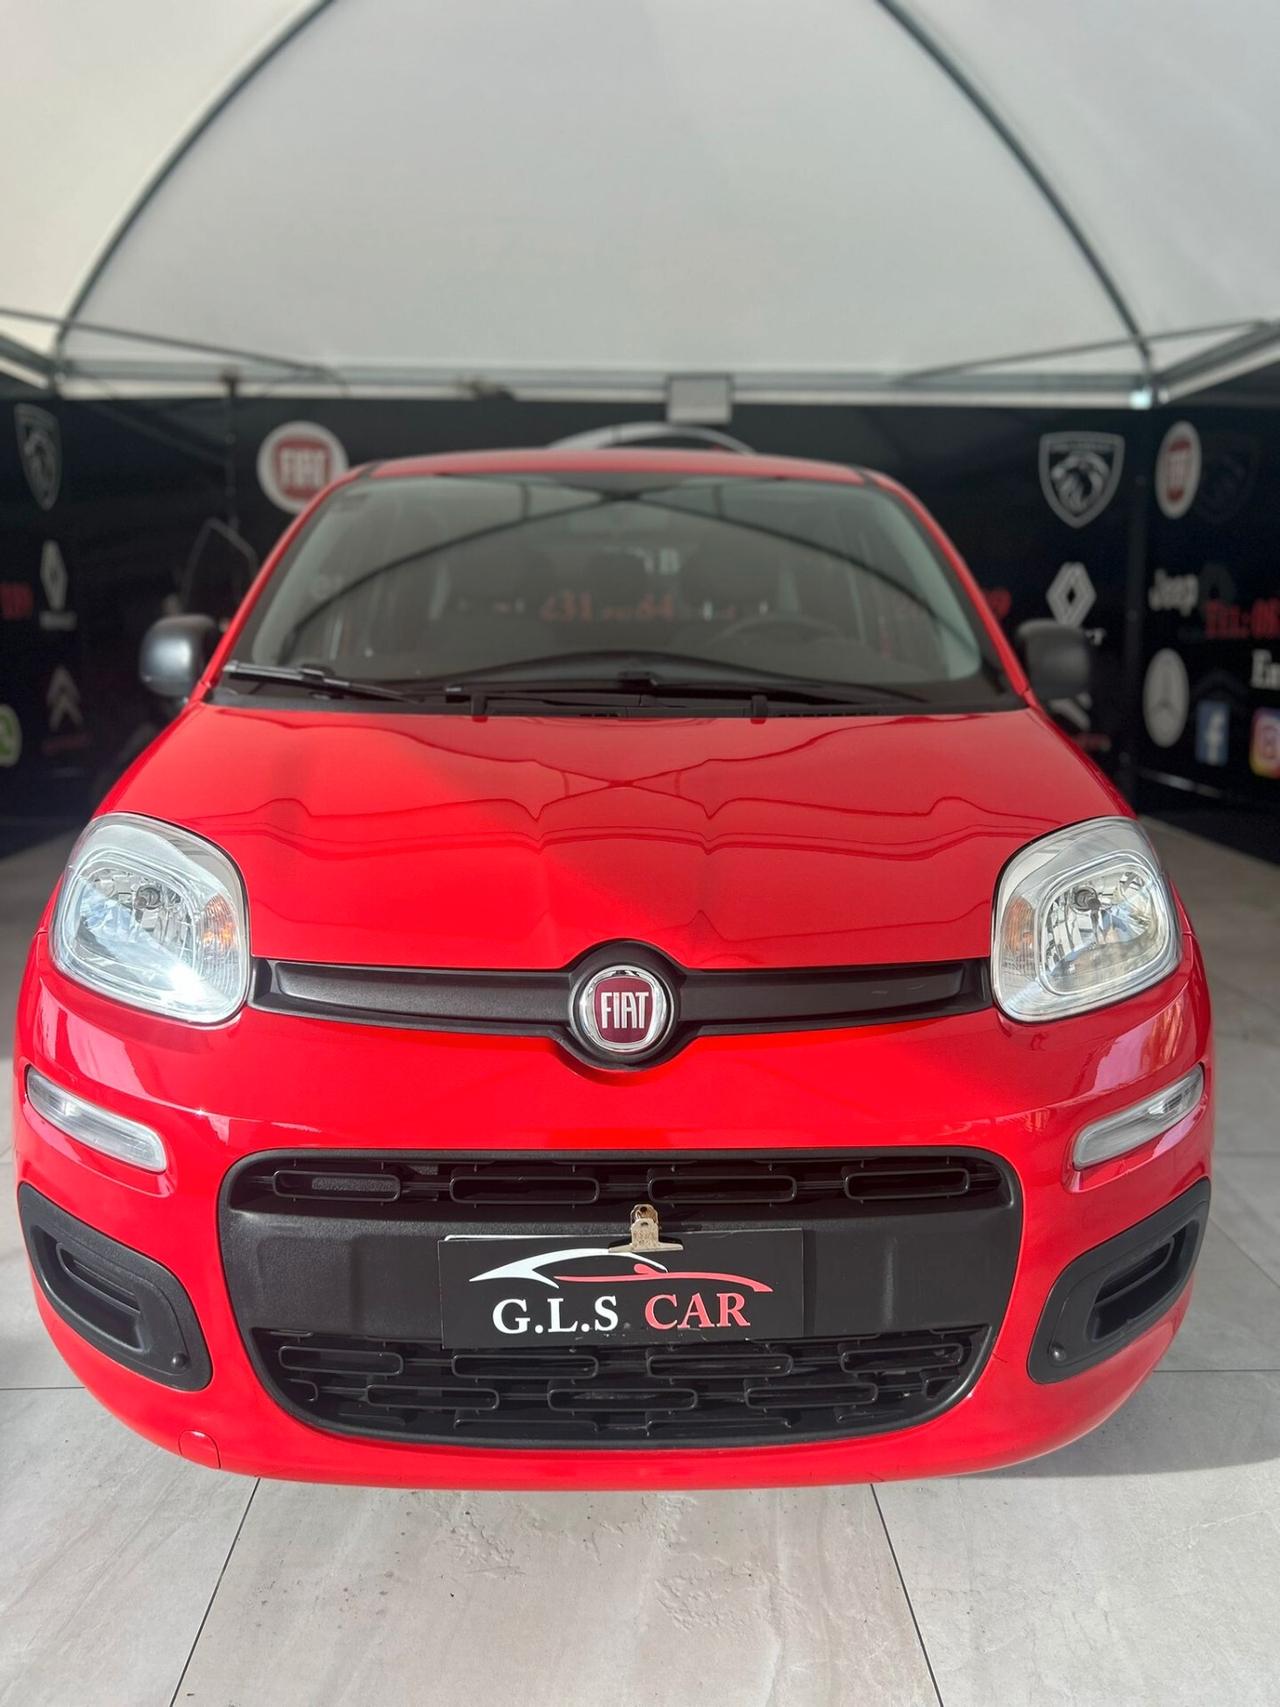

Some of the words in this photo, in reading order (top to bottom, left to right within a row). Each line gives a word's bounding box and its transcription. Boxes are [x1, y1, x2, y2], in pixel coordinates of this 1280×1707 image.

[601, 992, 649, 1029] FIAT
[492, 1295, 619, 1334] G.L.S
[644, 1292, 750, 1330] CAR
